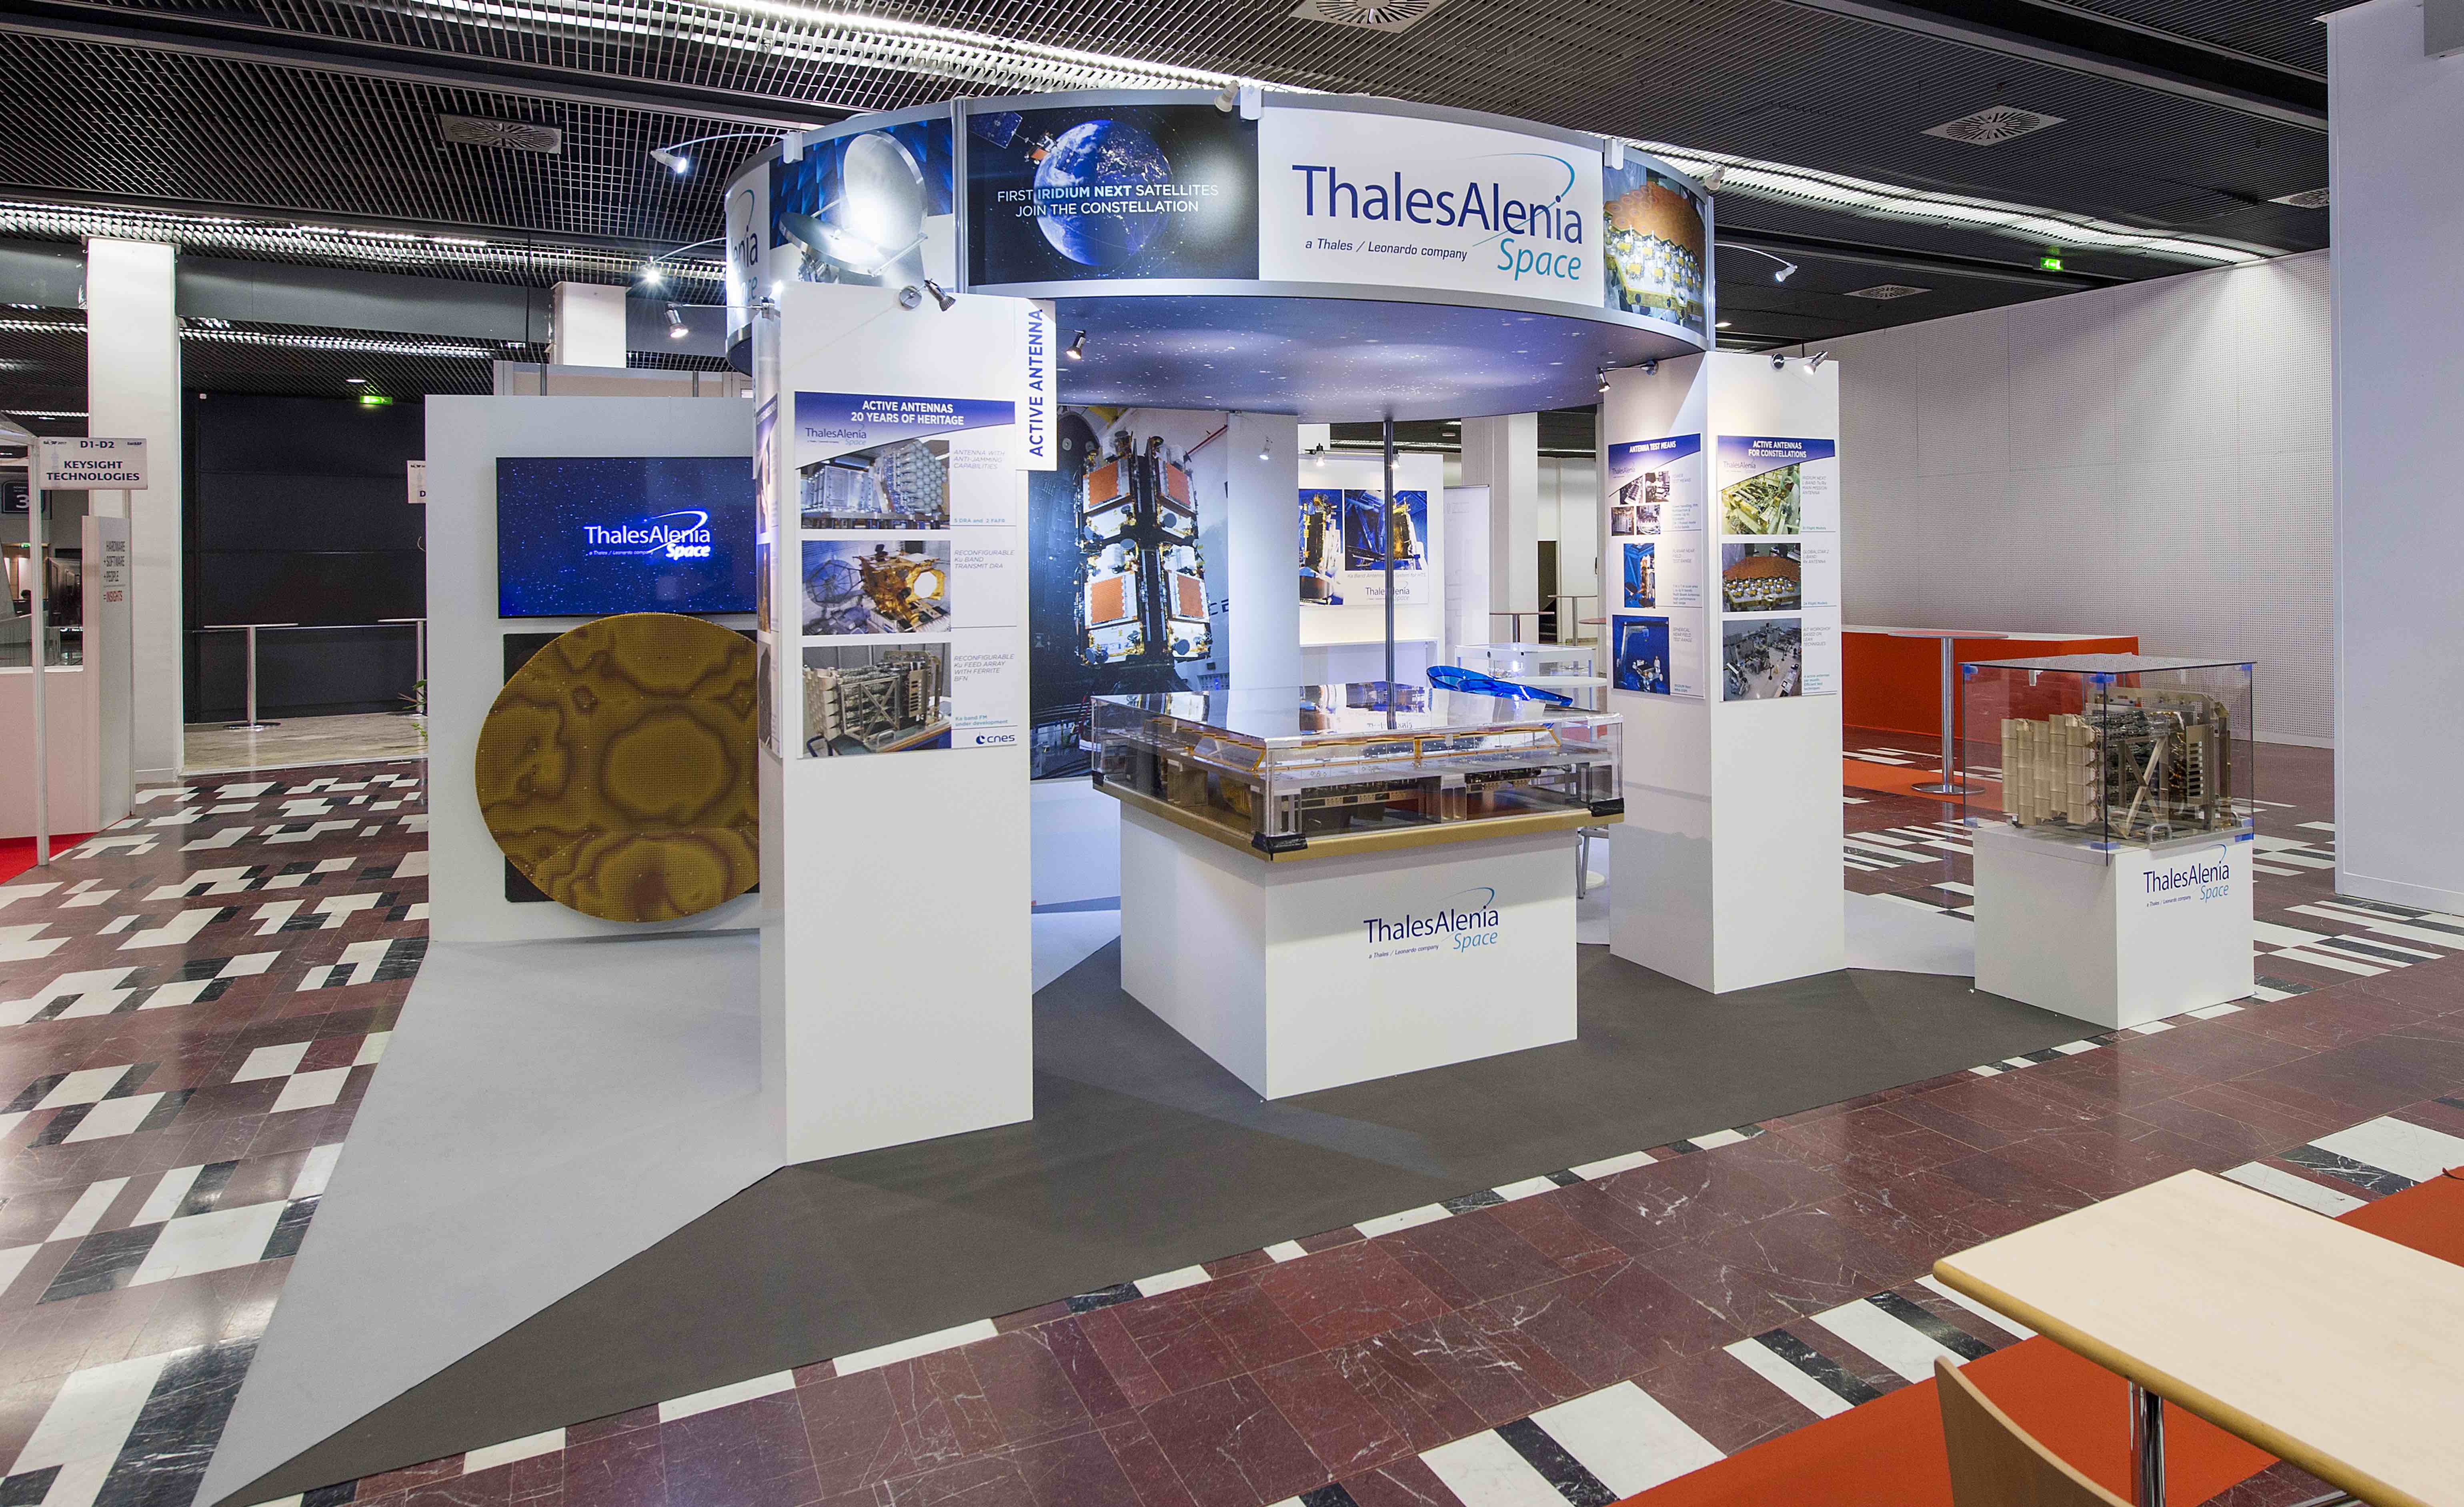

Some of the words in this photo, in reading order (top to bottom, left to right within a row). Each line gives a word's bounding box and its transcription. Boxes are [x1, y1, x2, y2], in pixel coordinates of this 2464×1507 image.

[998, 189, 1033, 203] FIRST
[1037, 186, 1091, 200] IRIDIUM
[1094, 185, 1132, 198] NEXT
[1135, 183, 1219, 197] SATELLITES
[1015, 203, 1046, 217] JOIN
[1051, 201, 1077, 215] THE
[1080, 200, 1199, 215] CONSTELLATION
[1292, 164, 1583, 244] ThalesAlenia
[1305, 242, 1313, 250] a
[1317, 238, 1353, 253] Thales
[1368, 241, 1417, 256] Leonardo
[1420, 247, 1467, 263] company
[1497, 238, 1582, 281] Space
[1028, 309, 1043, 391] ANTENNA
[862, 400, 898, 412] ACTIVE
[901, 402, 954, 414] ANTENNAS
[851, 412, 864, 422] 20
[866, 412, 899, 423] YEARS
[901, 414, 915, 424] OF
[918, 414, 965, 426] HERITAGE
[1029, 396, 1043, 457] ACTIVE
[805, 427, 867, 439] ThalesAlenia
[1629, 444, 1649, 454] ANTENNA
[1649, 443, 1660, 451] TEST
[1660, 440, 1676, 450] MEANS
[1761, 449, 1807, 458] CONSTELLATIONS
[64, 460, 123, 469] KEYSIGHT
[46, 472, 140, 481] TECHNOLOGIES
[583, 524, 711, 544] ThalesAlenia
[665, 543, 711, 561] Space
[987, 734, 1015, 743] cnes
[2143, 861, 2229, 893] ThalesAlenia
[2200, 884, 2229, 903] Space
[1363, 905, 1499, 943] ThalesAlenia
[1395, 947, 1417, 955] Leonardo
[1417, 944, 1439, 952] company
[1453, 931, 1498, 953] Space
